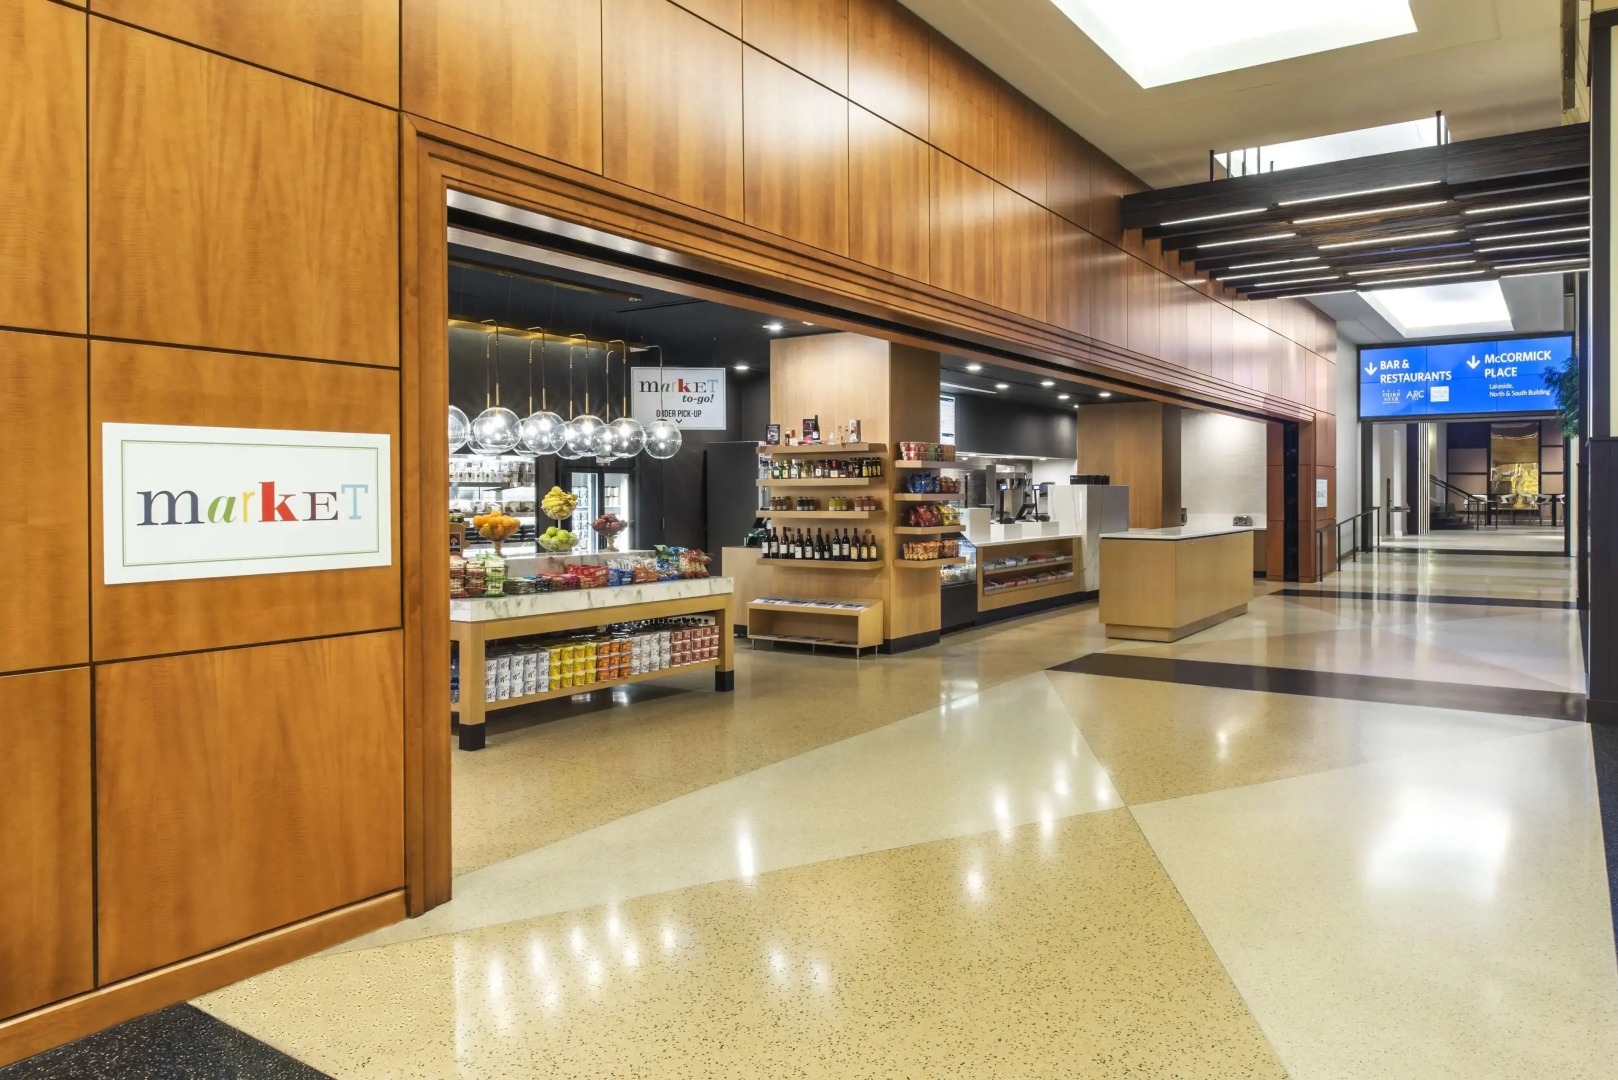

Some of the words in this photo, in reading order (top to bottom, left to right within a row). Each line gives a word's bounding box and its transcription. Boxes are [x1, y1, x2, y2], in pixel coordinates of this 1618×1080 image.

[1485, 351, 1551, 364] McCORMICK
[1380, 360, 1400, 370] BAR
[1402, 359, 1409, 368] &
[1380, 371, 1452, 383] RESTAURANTS
[1485, 367, 1517, 378] PLACE
[683, 394, 714, 404] to-go!
